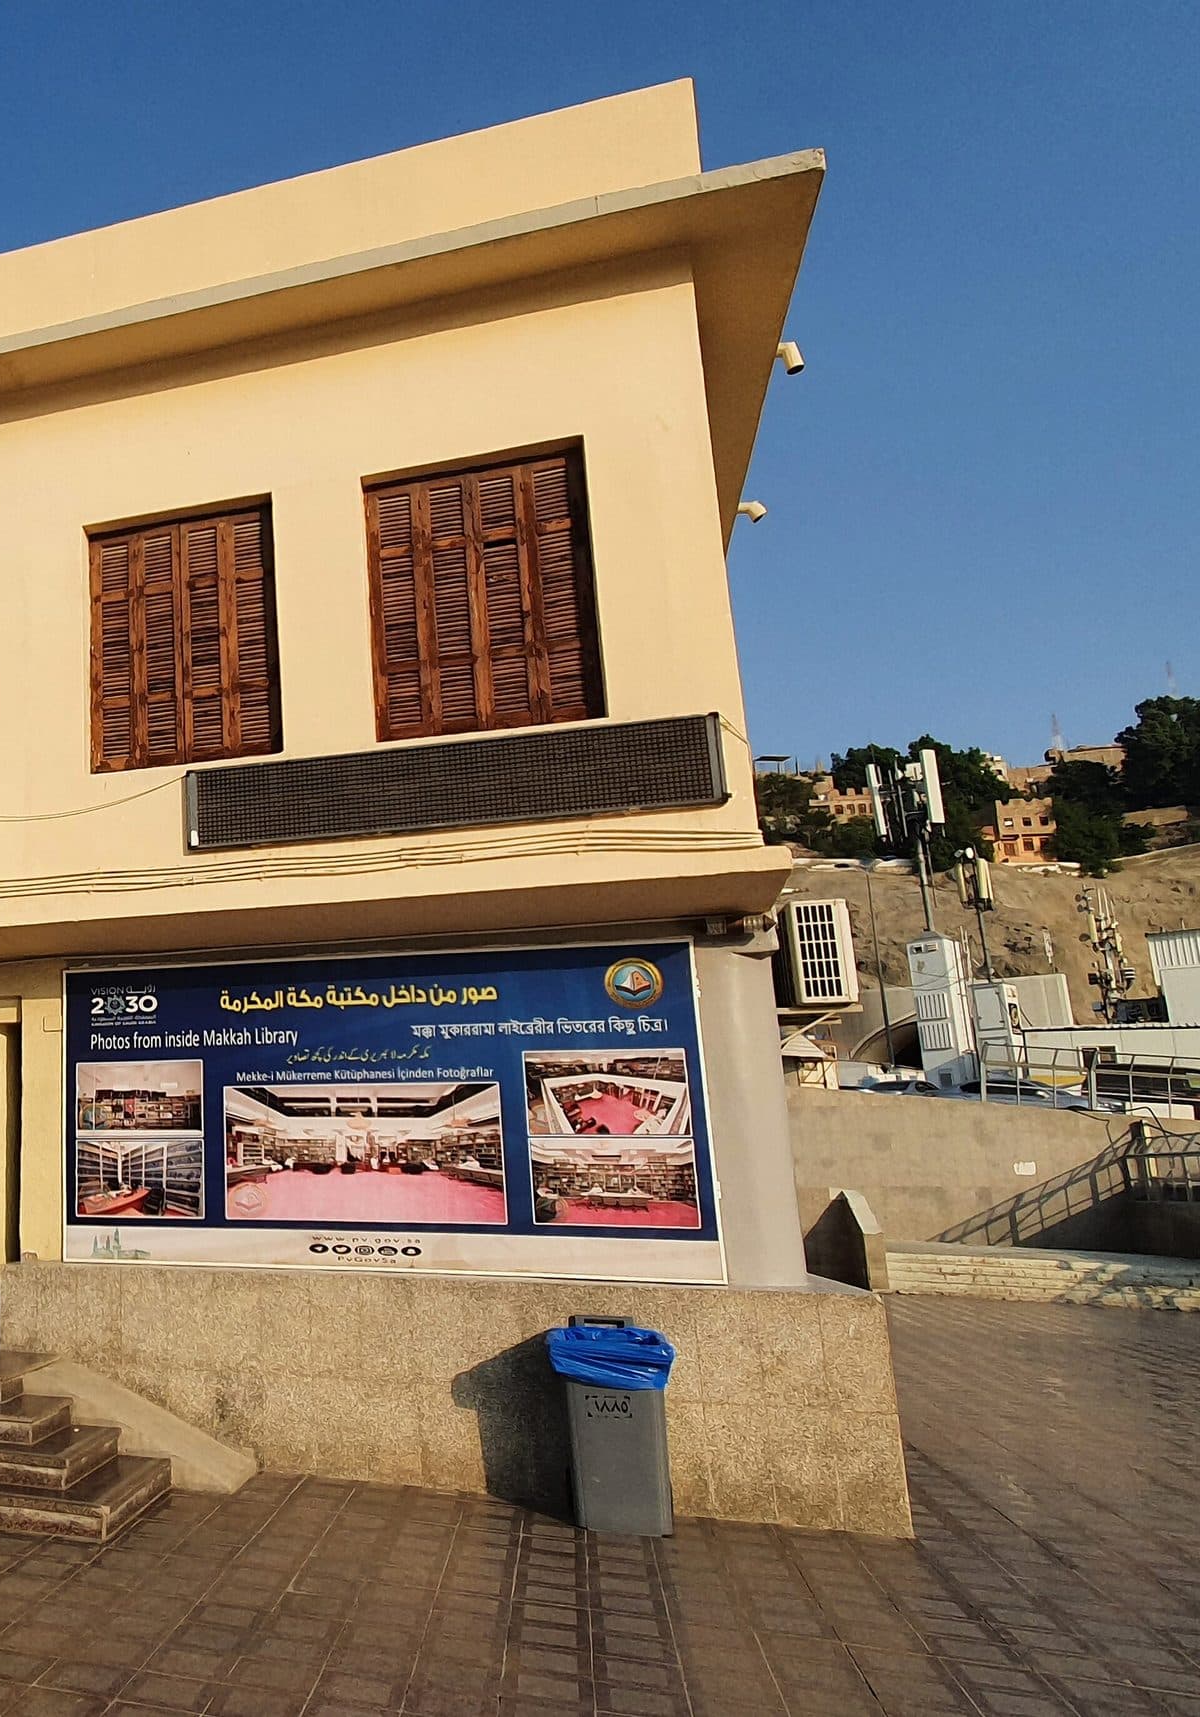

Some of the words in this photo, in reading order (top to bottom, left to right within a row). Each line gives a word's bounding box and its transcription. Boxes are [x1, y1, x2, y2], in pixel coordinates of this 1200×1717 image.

[90, 986, 124, 996] VISION
[220, 989, 284, 1014] المكرمة
[286, 986, 324, 1009] مكة
[326, 984, 380, 1011] مكتبة
[382, 983, 427, 1008] داخل
[429, 983, 457, 1007] من
[461, 985, 498, 1006] صور
[90, 1033, 130, 1050] Photos
[133, 1033, 161, 1049] from
[164, 1031, 200, 1048] inside
[203, 1028, 251, 1047] Makkah
[255, 1027, 298, 1047] Library
[410, 1023, 436, 1039] মক্কা
[557, 1016, 606, 1035] ভিতরের
[608, 1015, 637, 1035] কিছু
[236, 1071, 274, 1083] Mekke-i
[276, 1070, 332, 1081] Mükerreme
[334, 1067, 395, 1082] Kütüphanesi
[437, 1065, 494, 1080] Fotoğraflar
